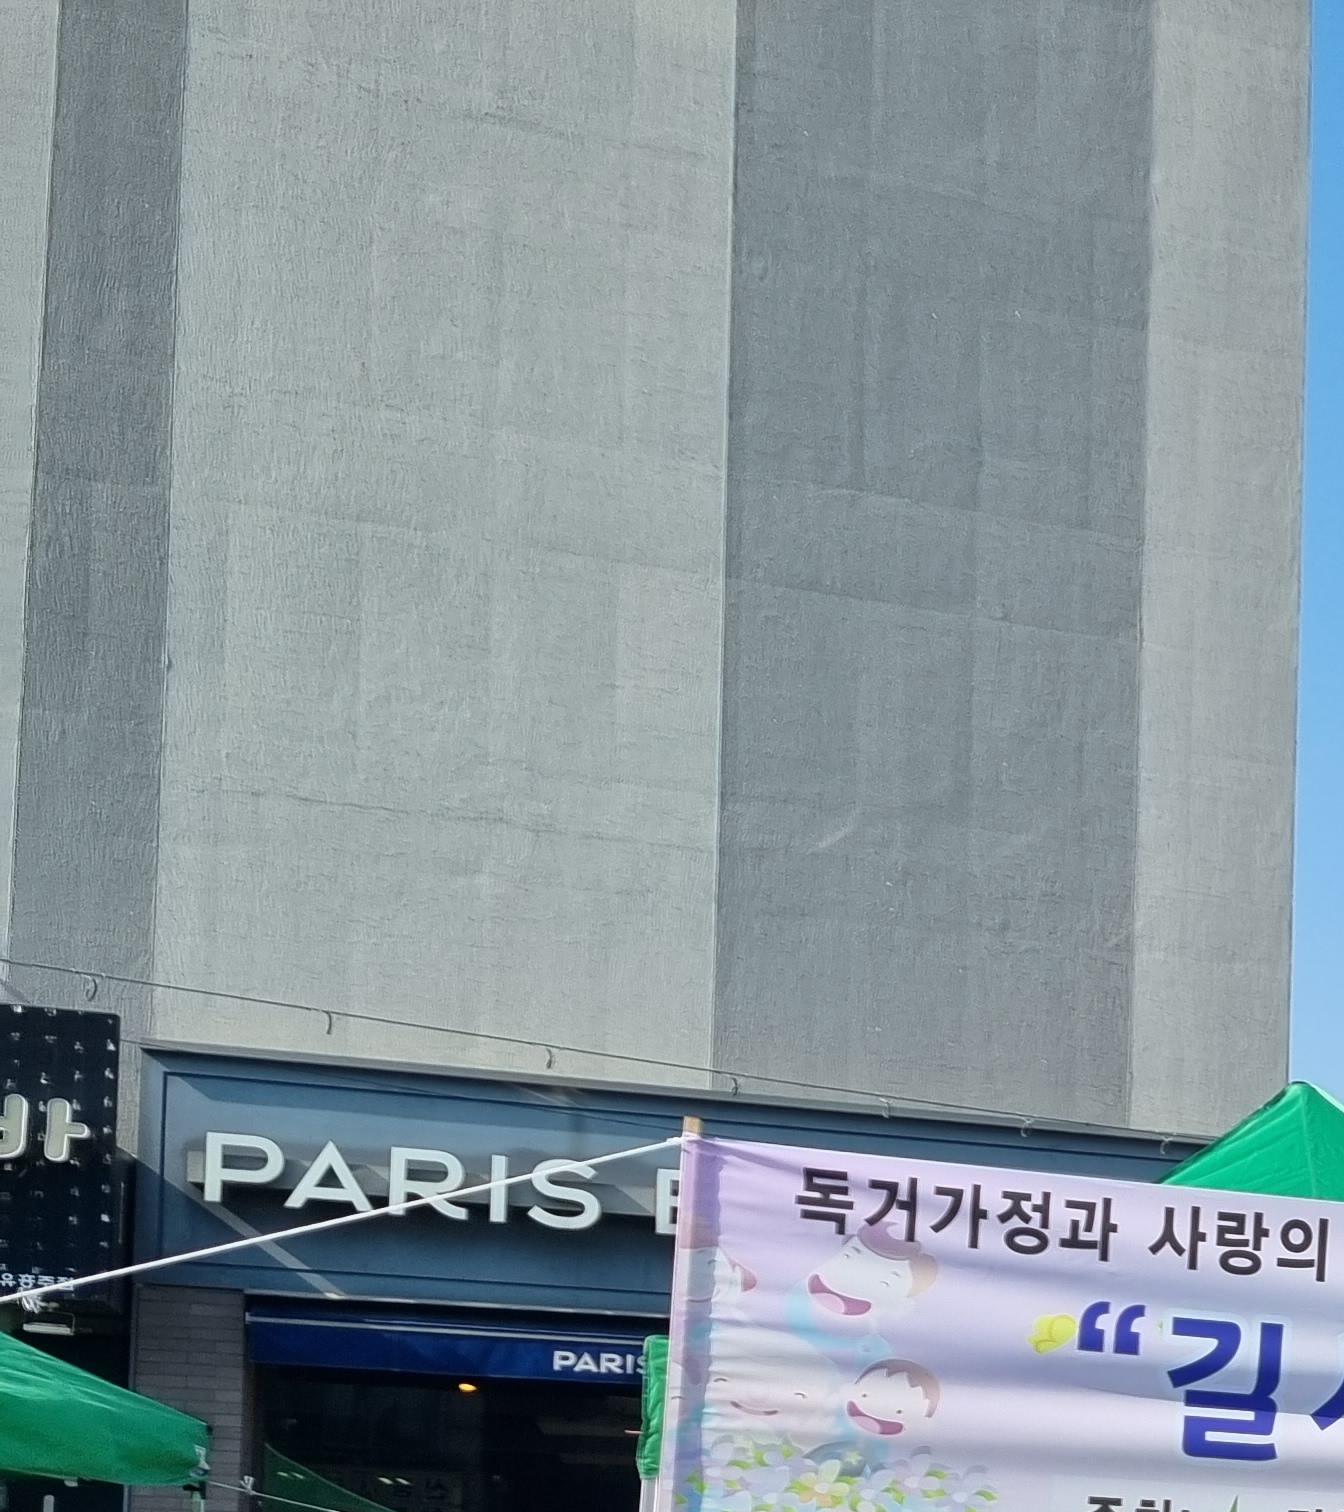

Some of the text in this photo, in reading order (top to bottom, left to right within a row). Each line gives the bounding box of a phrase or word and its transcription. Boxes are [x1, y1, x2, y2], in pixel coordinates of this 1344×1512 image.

[205, 1131, 602, 1231] PARIS
[795, 1166, 1118, 1261] 독거가정과
[1148, 1205, 1330, 1282] 사랑의
